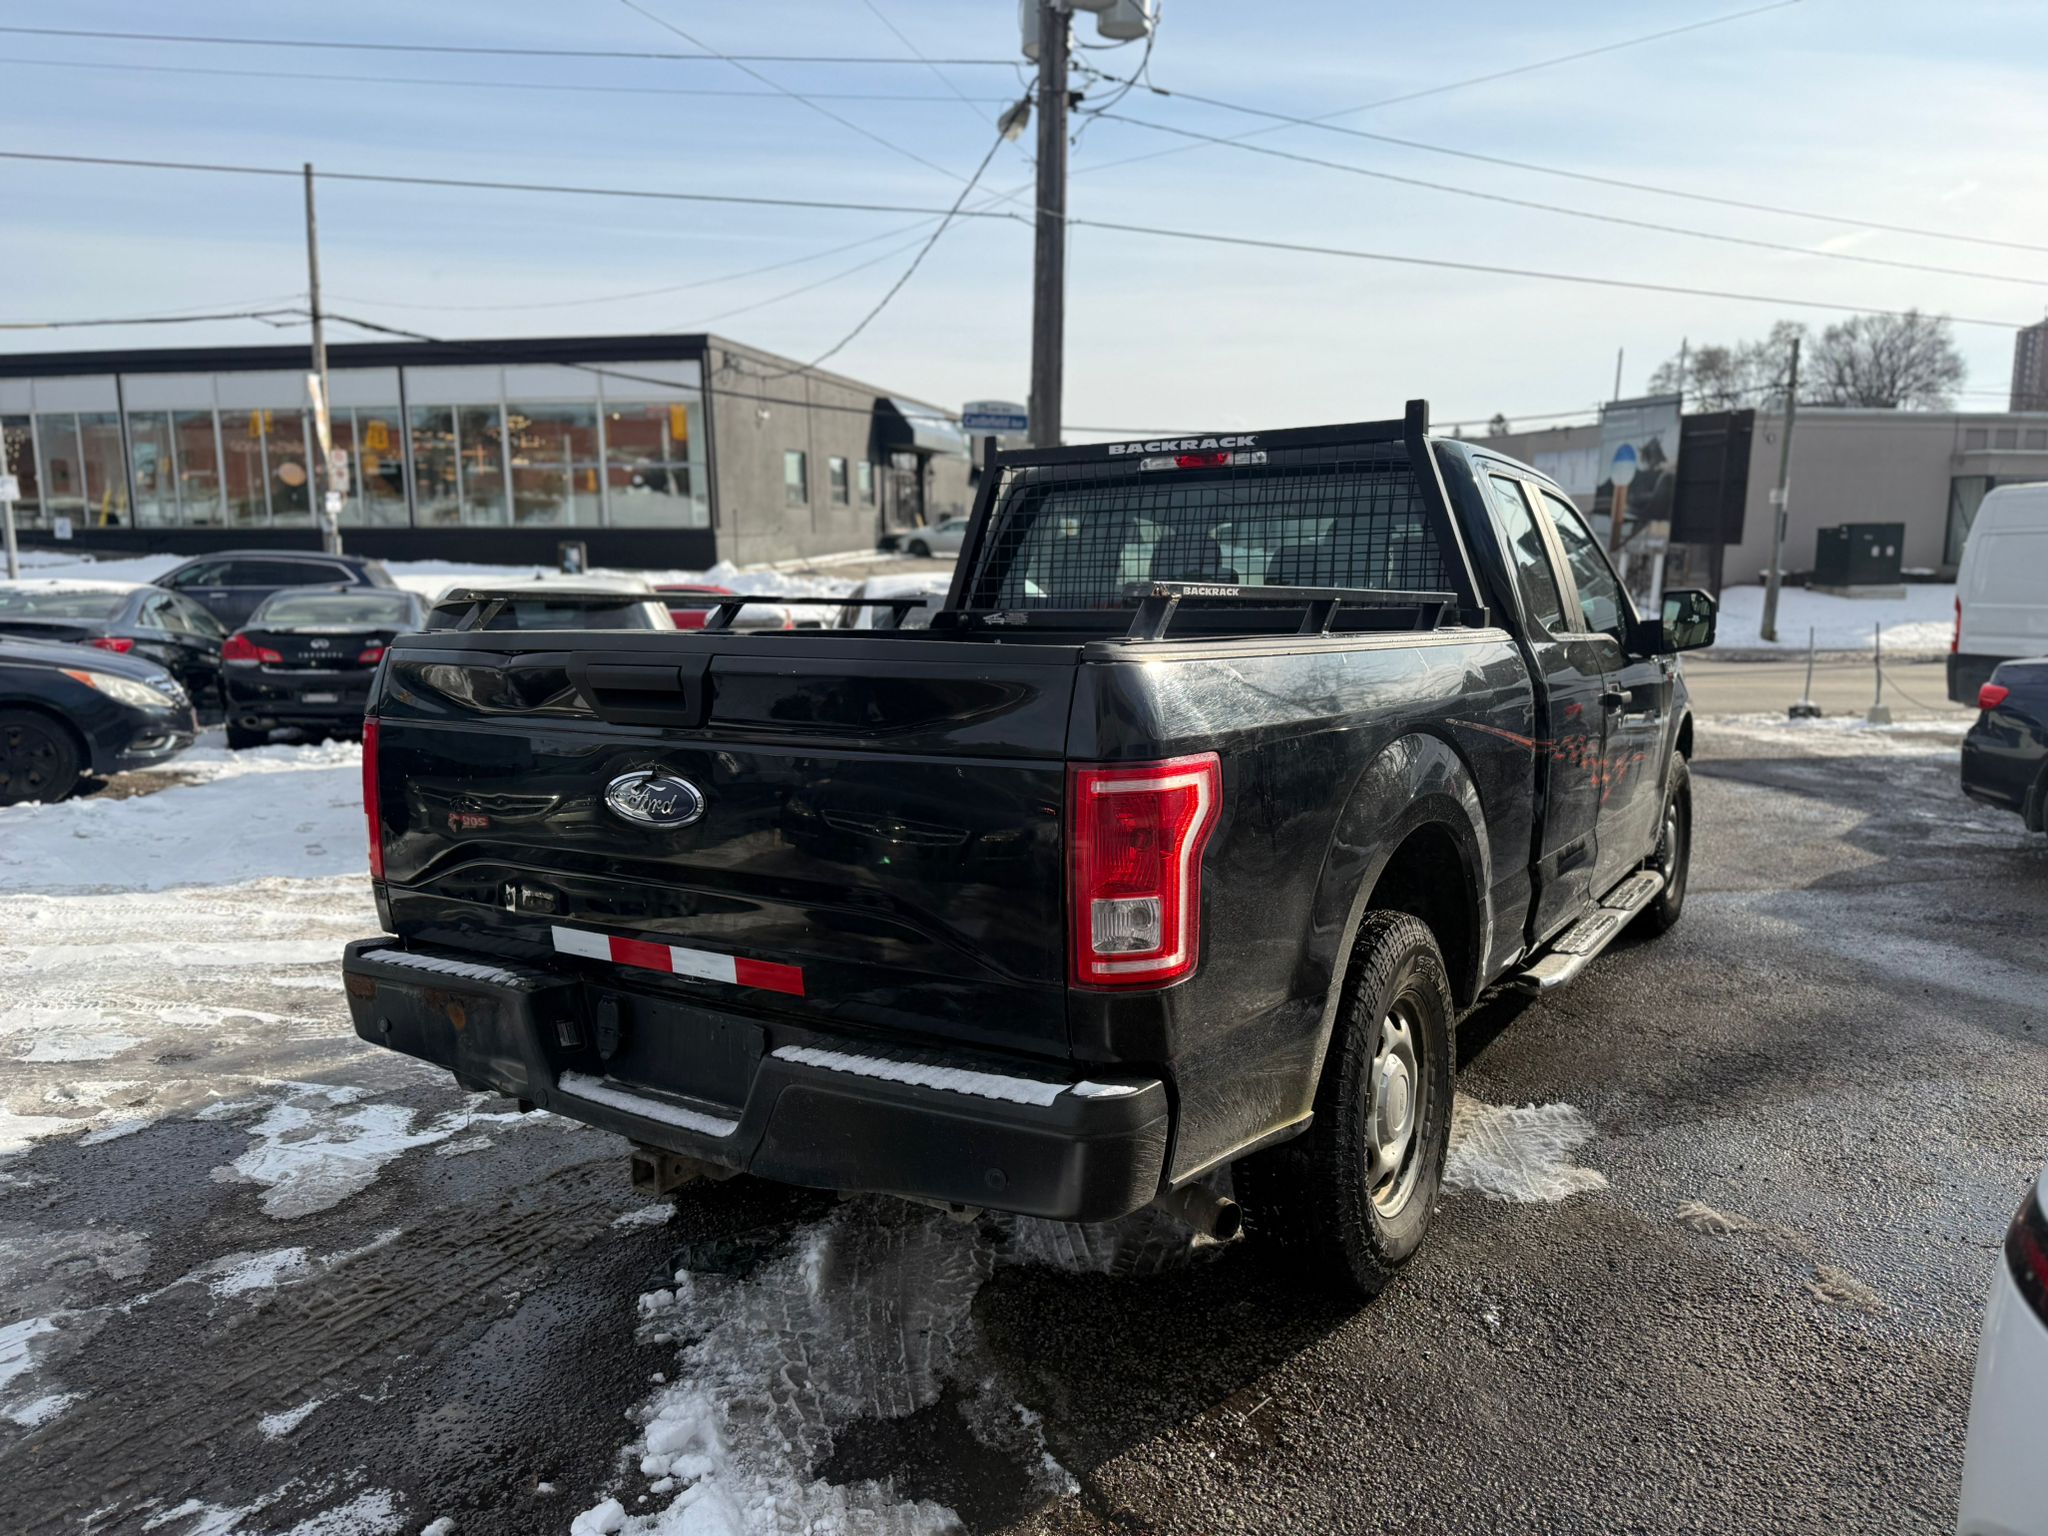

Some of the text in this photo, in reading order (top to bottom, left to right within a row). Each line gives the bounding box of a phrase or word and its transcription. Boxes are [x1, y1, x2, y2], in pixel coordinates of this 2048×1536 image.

[1108, 435, 1256, 455] BACKRACK
[1183, 586, 1240, 596] BACKRACK
[628, 783, 677, 815] Ford
